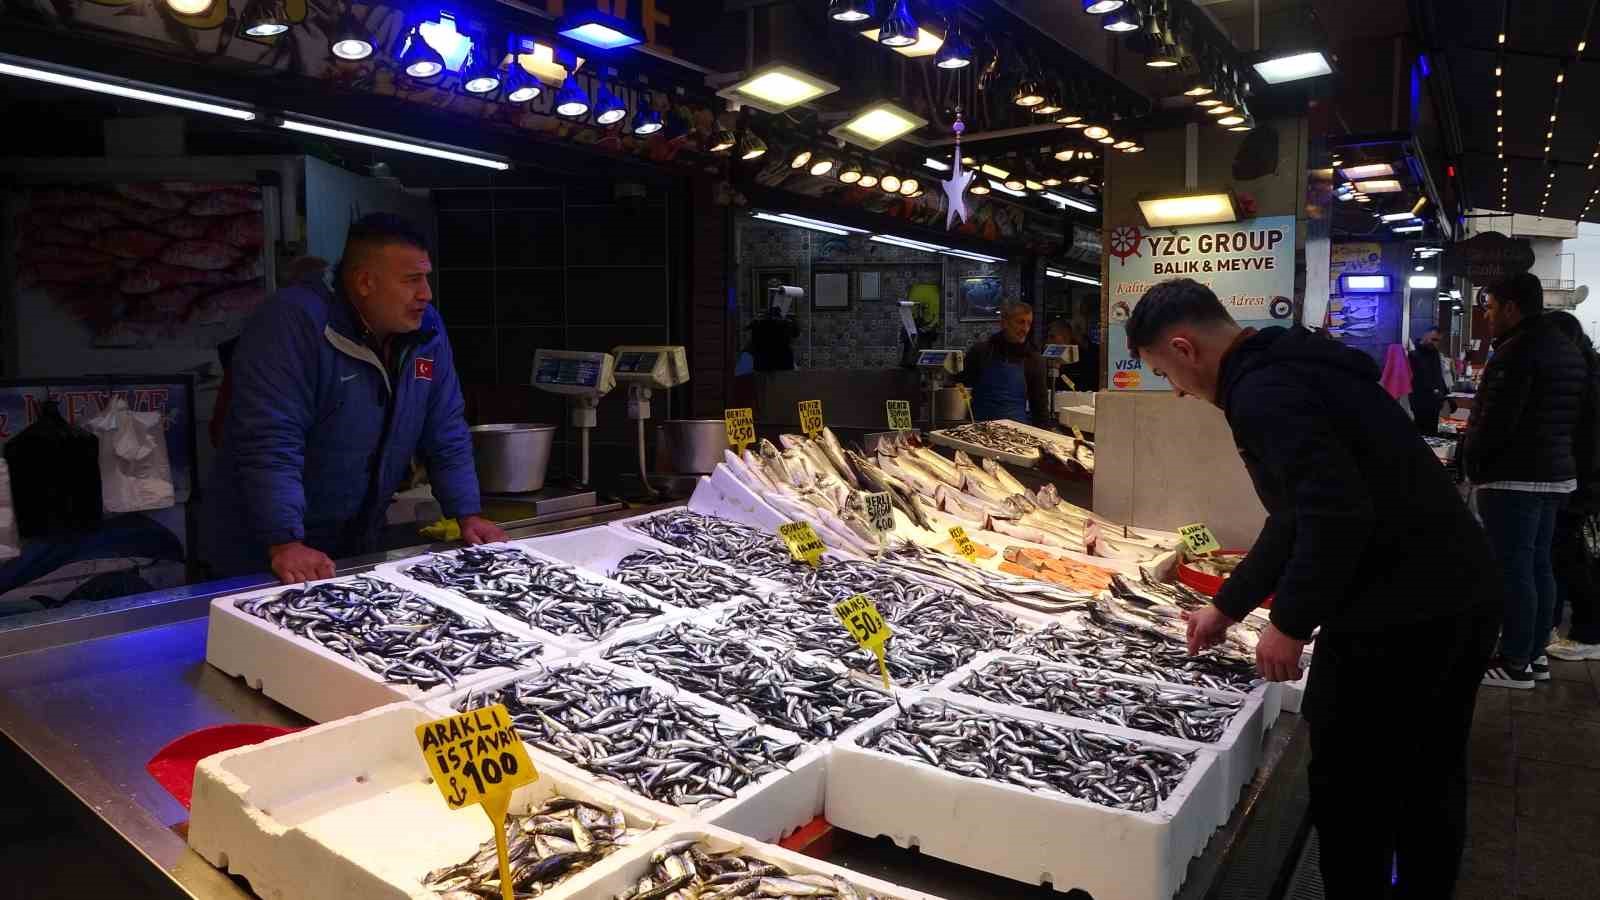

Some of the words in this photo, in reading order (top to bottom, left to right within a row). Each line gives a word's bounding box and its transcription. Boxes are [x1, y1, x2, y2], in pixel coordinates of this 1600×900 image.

[1149, 235, 1191, 257] YZC
[1198, 229, 1283, 254] GROUP
[1154, 260, 1199, 275] BALIK
[1202, 260, 1213, 273] &
[1217, 256, 1274, 272] MEYVE
[1115, 359, 1142, 370] VISA
[423, 710, 501, 752] ARAKLI
[462, 751, 518, 794] 100
